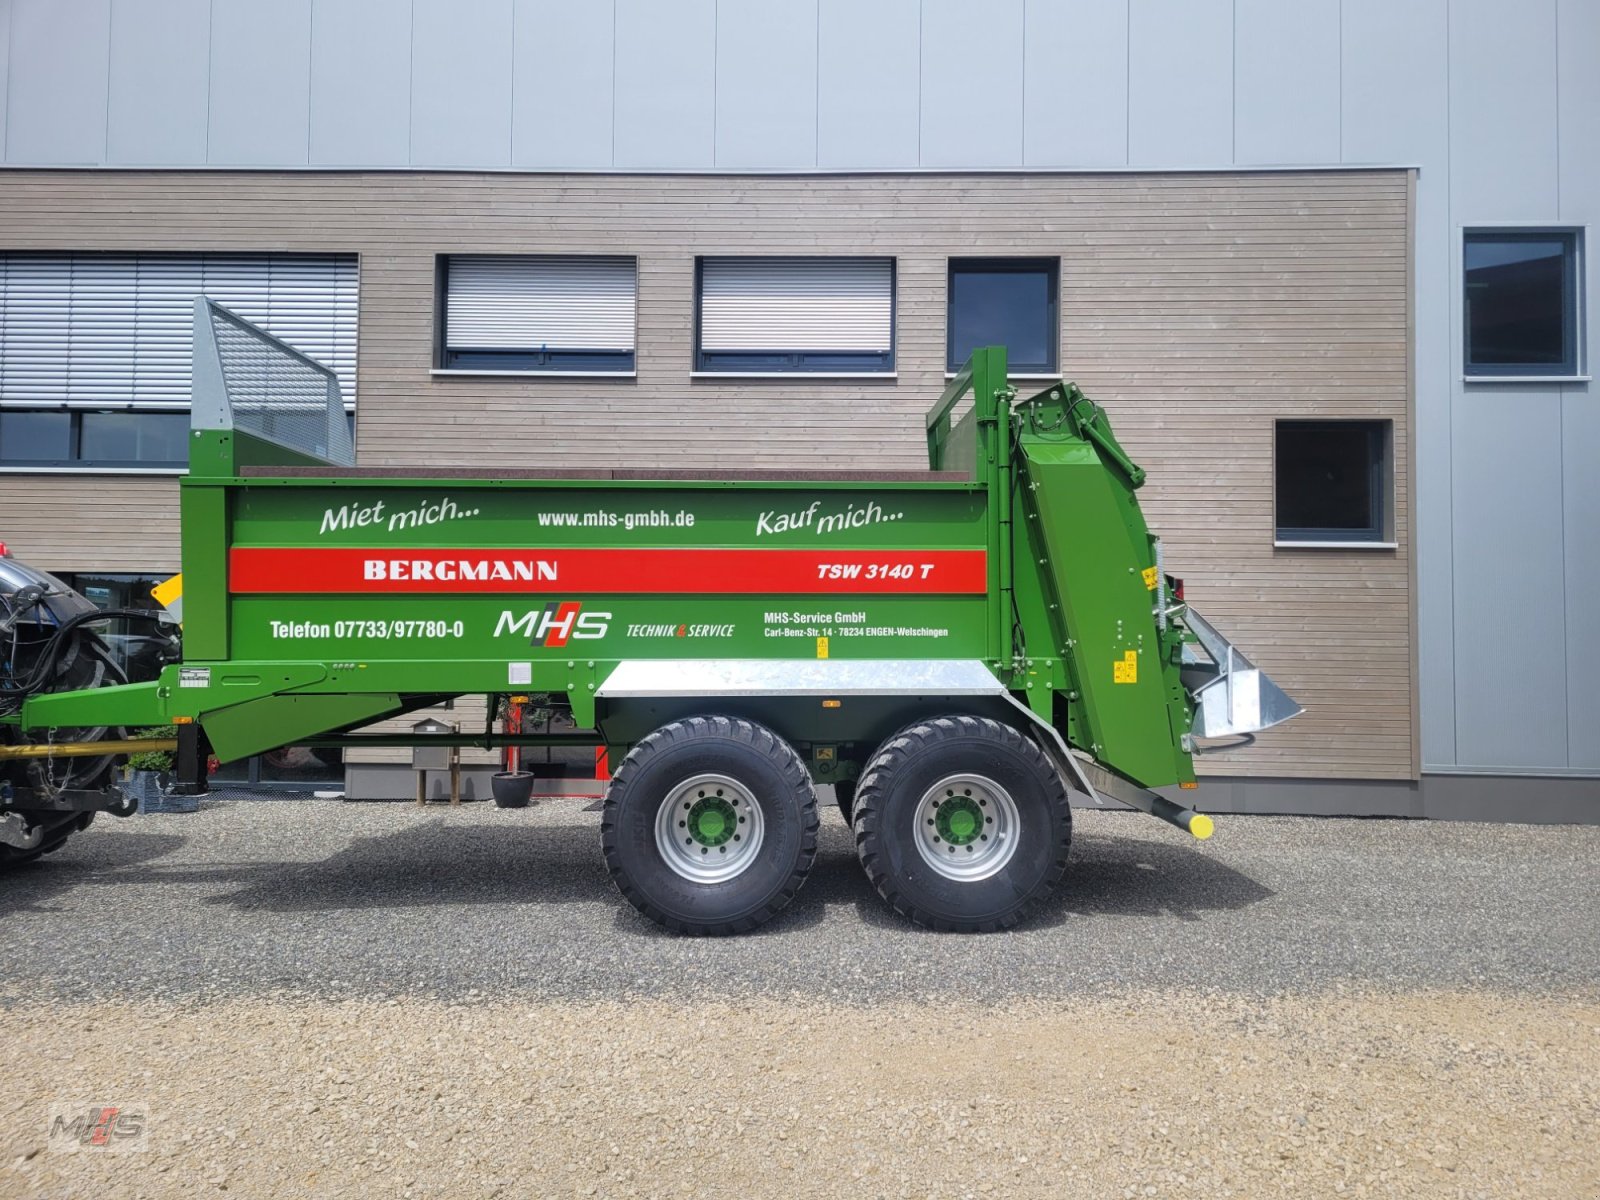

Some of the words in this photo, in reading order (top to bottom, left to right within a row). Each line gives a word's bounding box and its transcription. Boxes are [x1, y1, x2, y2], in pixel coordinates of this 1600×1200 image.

[319, 500, 385, 535] Miet
[388, 497, 480, 532] mich...
[537, 509, 695, 531] www.mhs-gmbh.de
[755, 500, 821, 537] Kauf
[816, 501, 904, 535] mich...
[363, 559, 558, 582] BERGMANN
[817, 563, 863, 580] TSW
[864, 563, 914, 580] 3140
[919, 563, 935, 580] T
[492, 609, 613, 640] MHS
[763, 611, 833, 624] MHS-Service
[834, 611, 866, 624] GmbH
[269, 620, 331, 639] Telefon
[333, 619, 465, 640] 07733/97780-0
[626, 624, 677, 638] TECHNIK
[677, 623, 686, 638] &
[687, 624, 736, 638] SERVICE
[764, 627, 821, 638] Carl-Benz-Str.
[822, 627, 833, 637] 14
[838, 627, 865, 637] 78234
[865, 626, 949, 639] ENGEN-Welschingen
